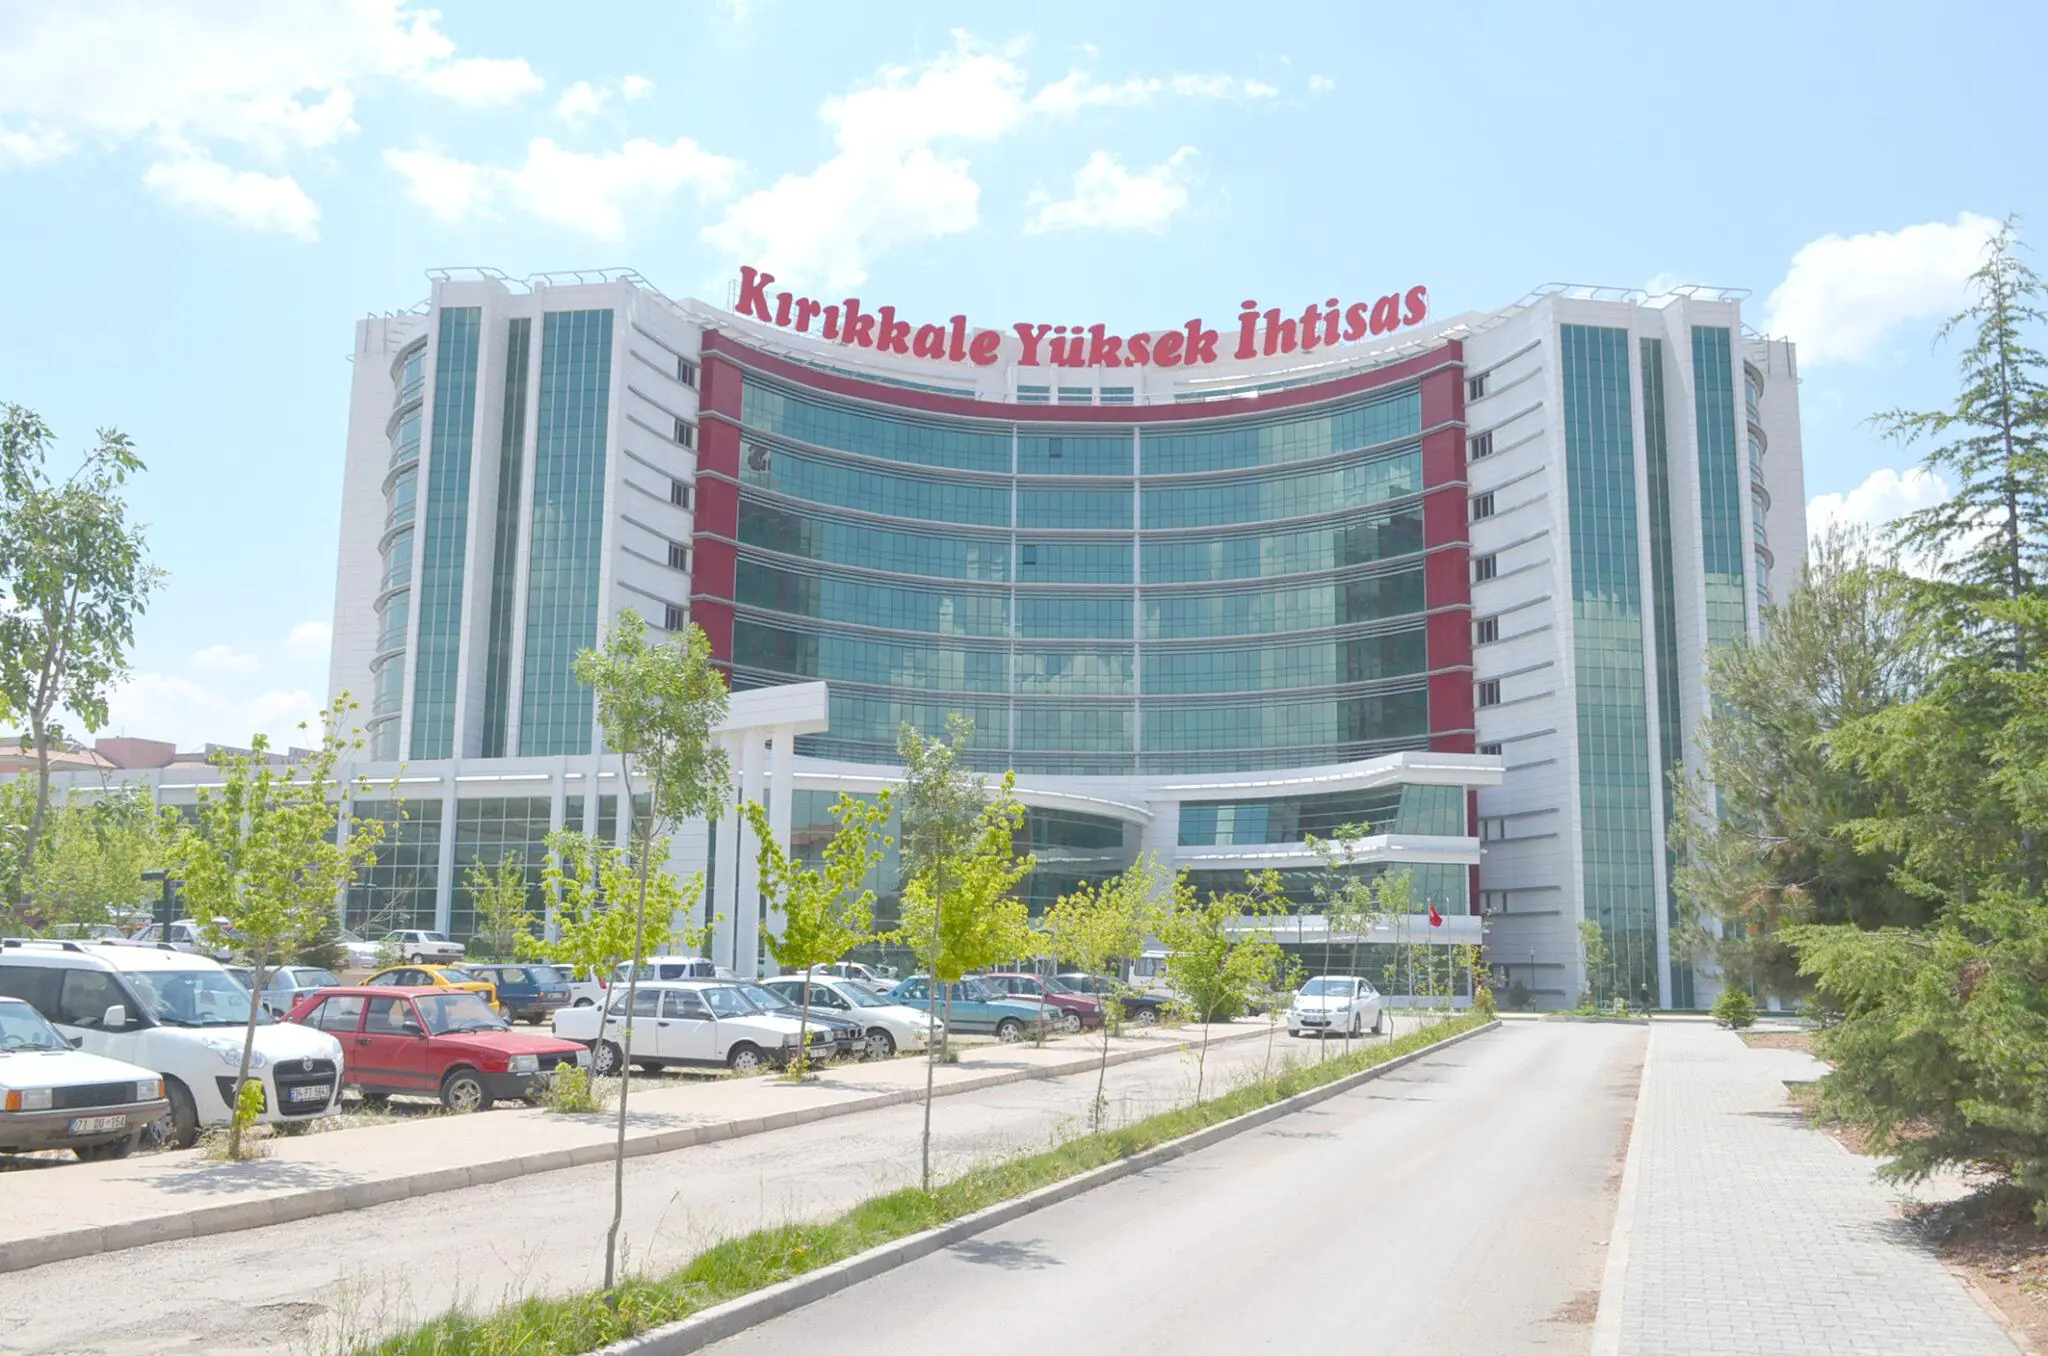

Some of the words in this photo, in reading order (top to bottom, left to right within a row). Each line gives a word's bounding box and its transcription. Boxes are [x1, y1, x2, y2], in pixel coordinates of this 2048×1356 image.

[735, 265, 1000, 366] Kırıkkale
[1013, 318, 1219, 368] Yüksek
[1234, 285, 1427, 360] İhtisas
